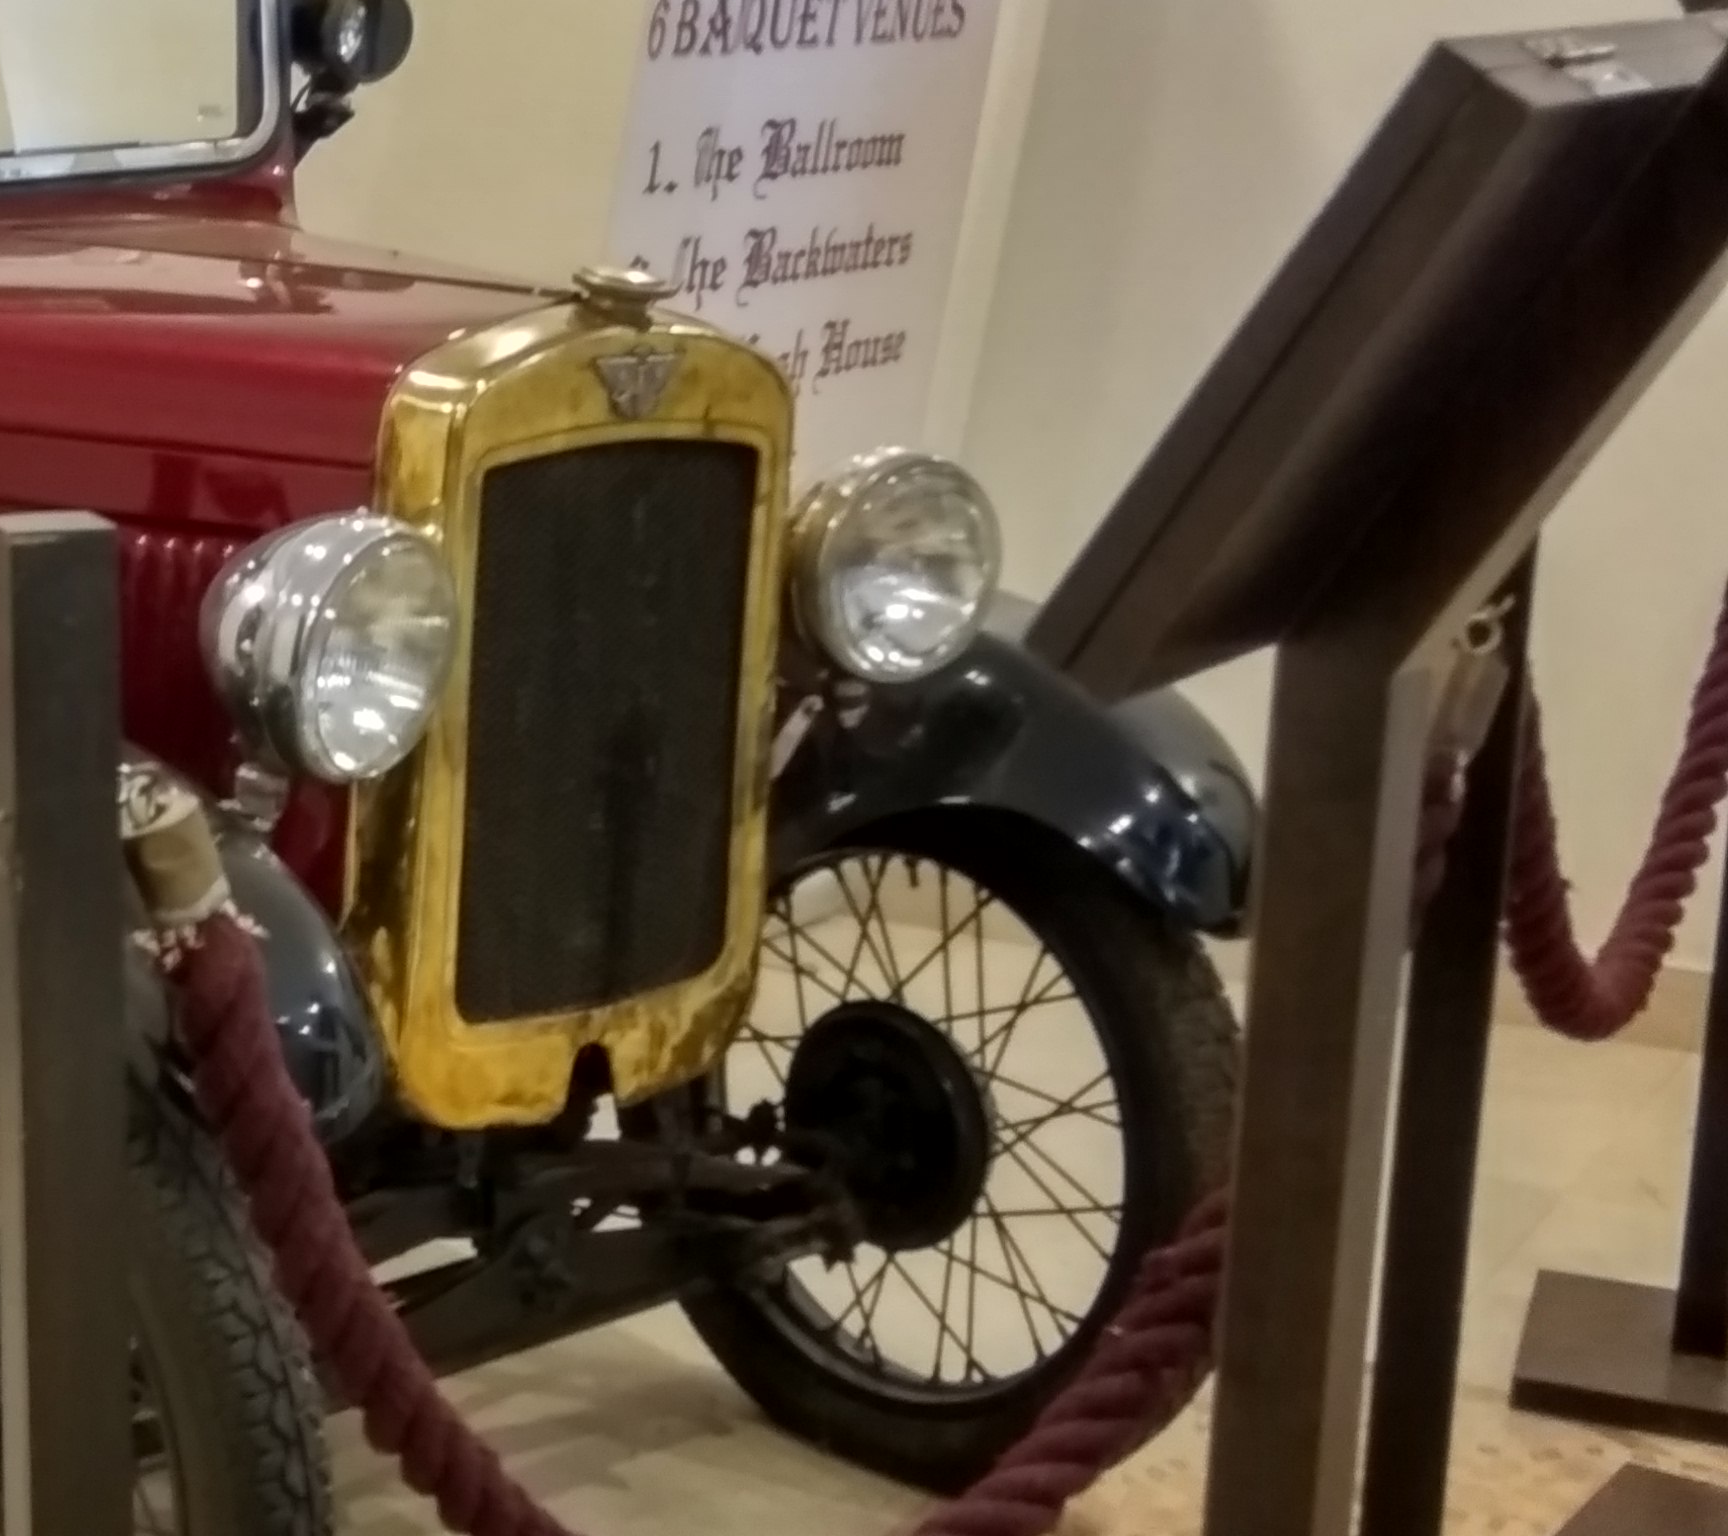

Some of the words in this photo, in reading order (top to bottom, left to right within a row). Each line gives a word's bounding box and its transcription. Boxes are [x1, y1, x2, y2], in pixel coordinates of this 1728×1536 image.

[643, 139, 678, 195] 1.
[753, 117, 905, 200] Ballroom
[735, 222, 913, 307] Backwaters
[811, 319, 906, 395] House
